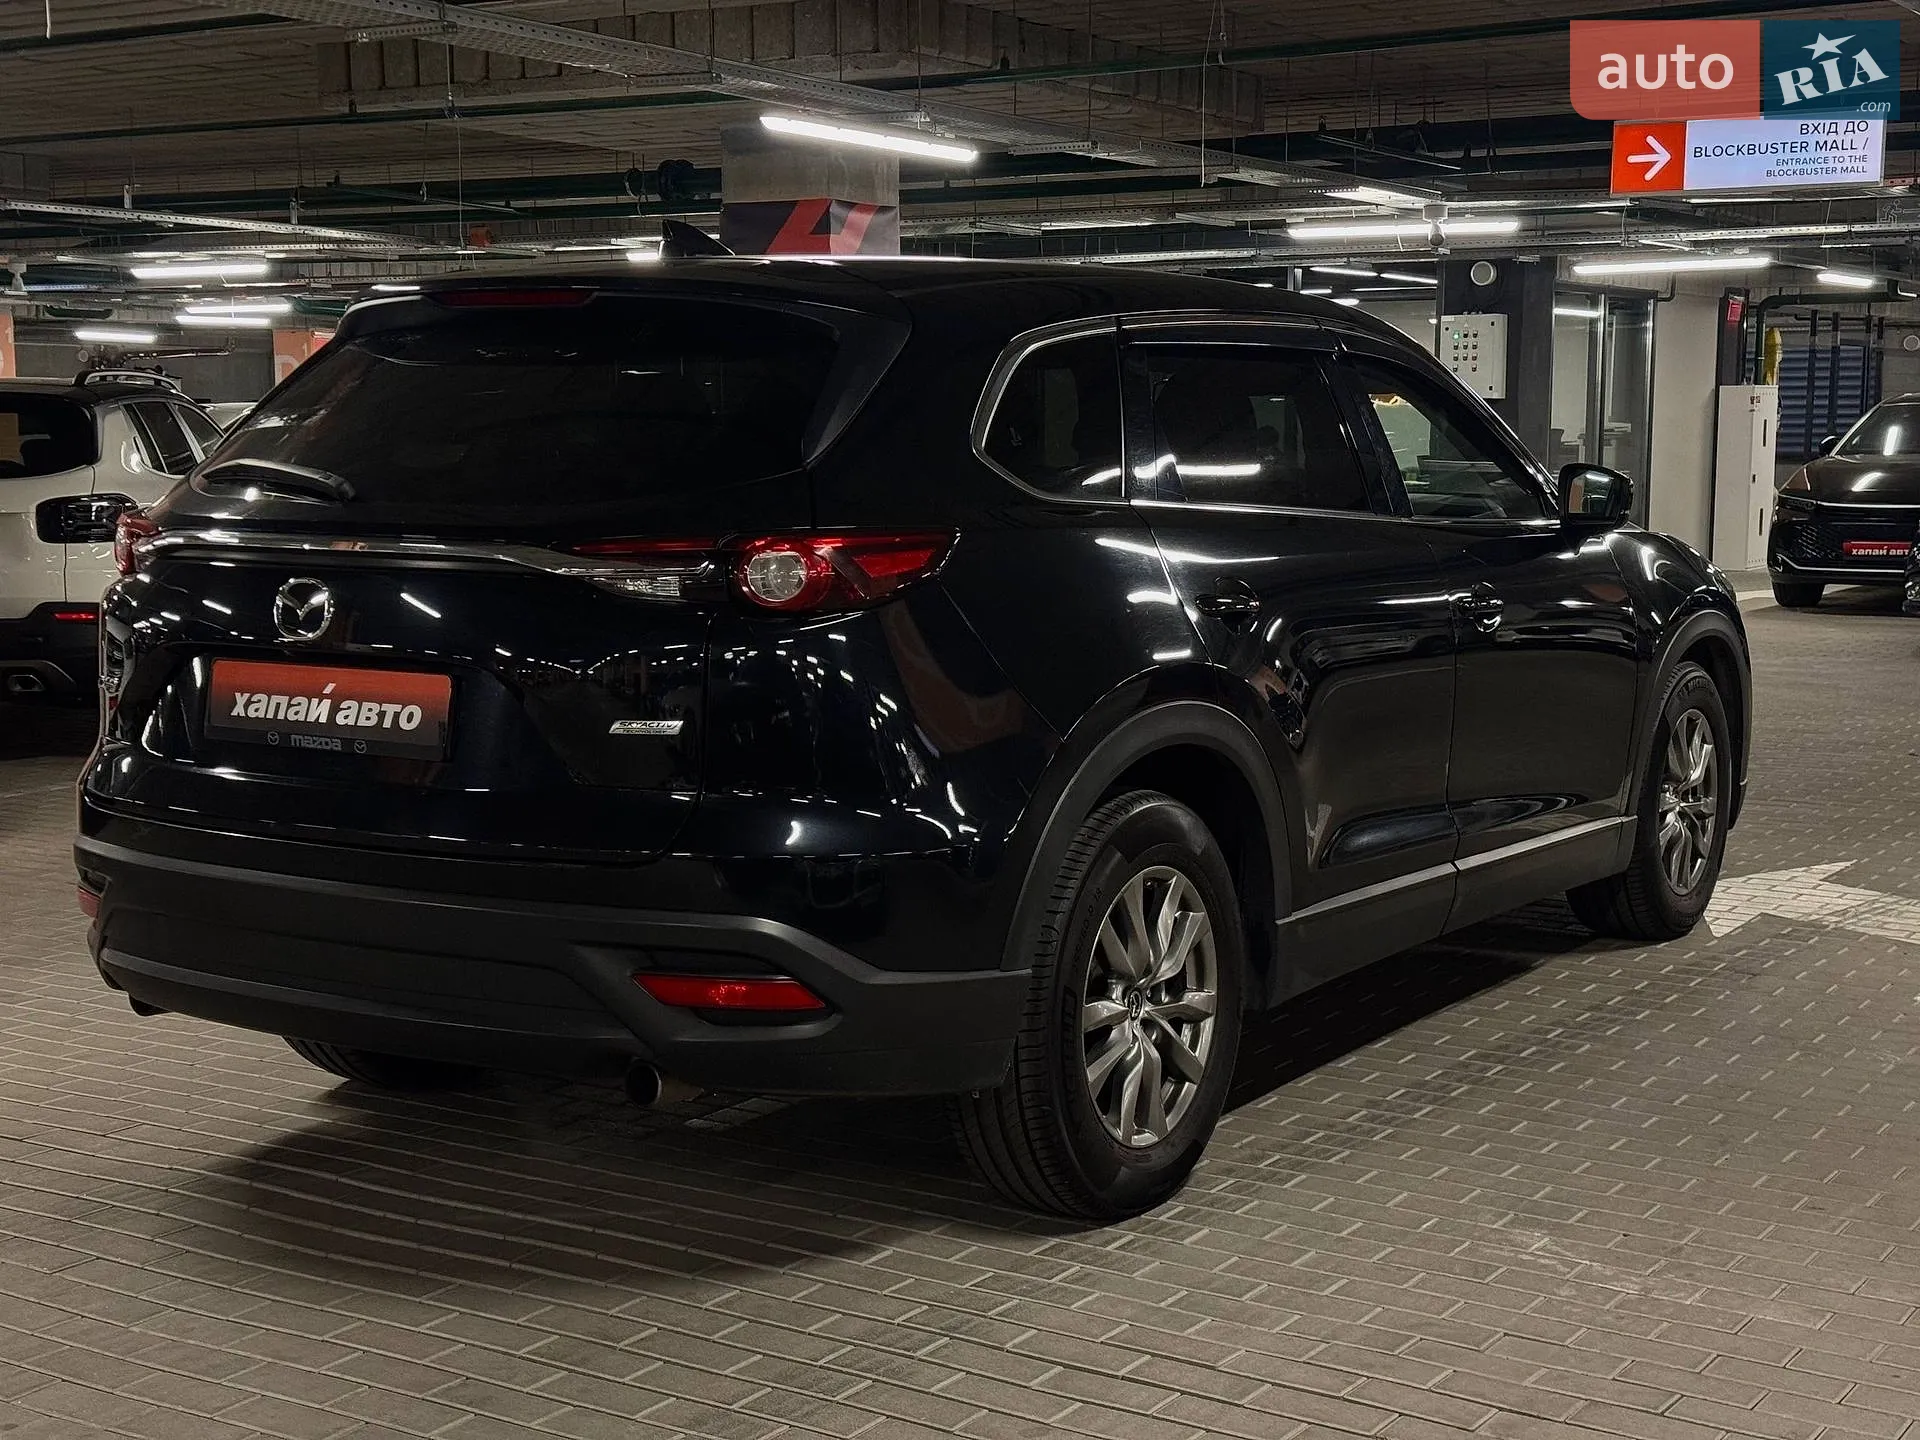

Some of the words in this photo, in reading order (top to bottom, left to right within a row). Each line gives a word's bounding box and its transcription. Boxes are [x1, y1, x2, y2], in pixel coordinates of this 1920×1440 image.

[1800, 121, 1839, 135] ВХІД
[1844, 120, 1869, 135] ДО
[1693, 141, 1809, 158] BLOCKBUSTER
[1815, 139, 1858, 152] MALL
[1862, 137, 1869, 150] /
[1776, 156, 1829, 167] ENTRANCE
[1832, 155, 1845, 164] TO
[1847, 154, 1868, 163] THE
[1766, 167, 1838, 177] BLOCKBUSTER
[1840, 165, 1867, 174] MALL
[231, 683, 337, 723] хапай
[335, 700, 422, 731] авто
